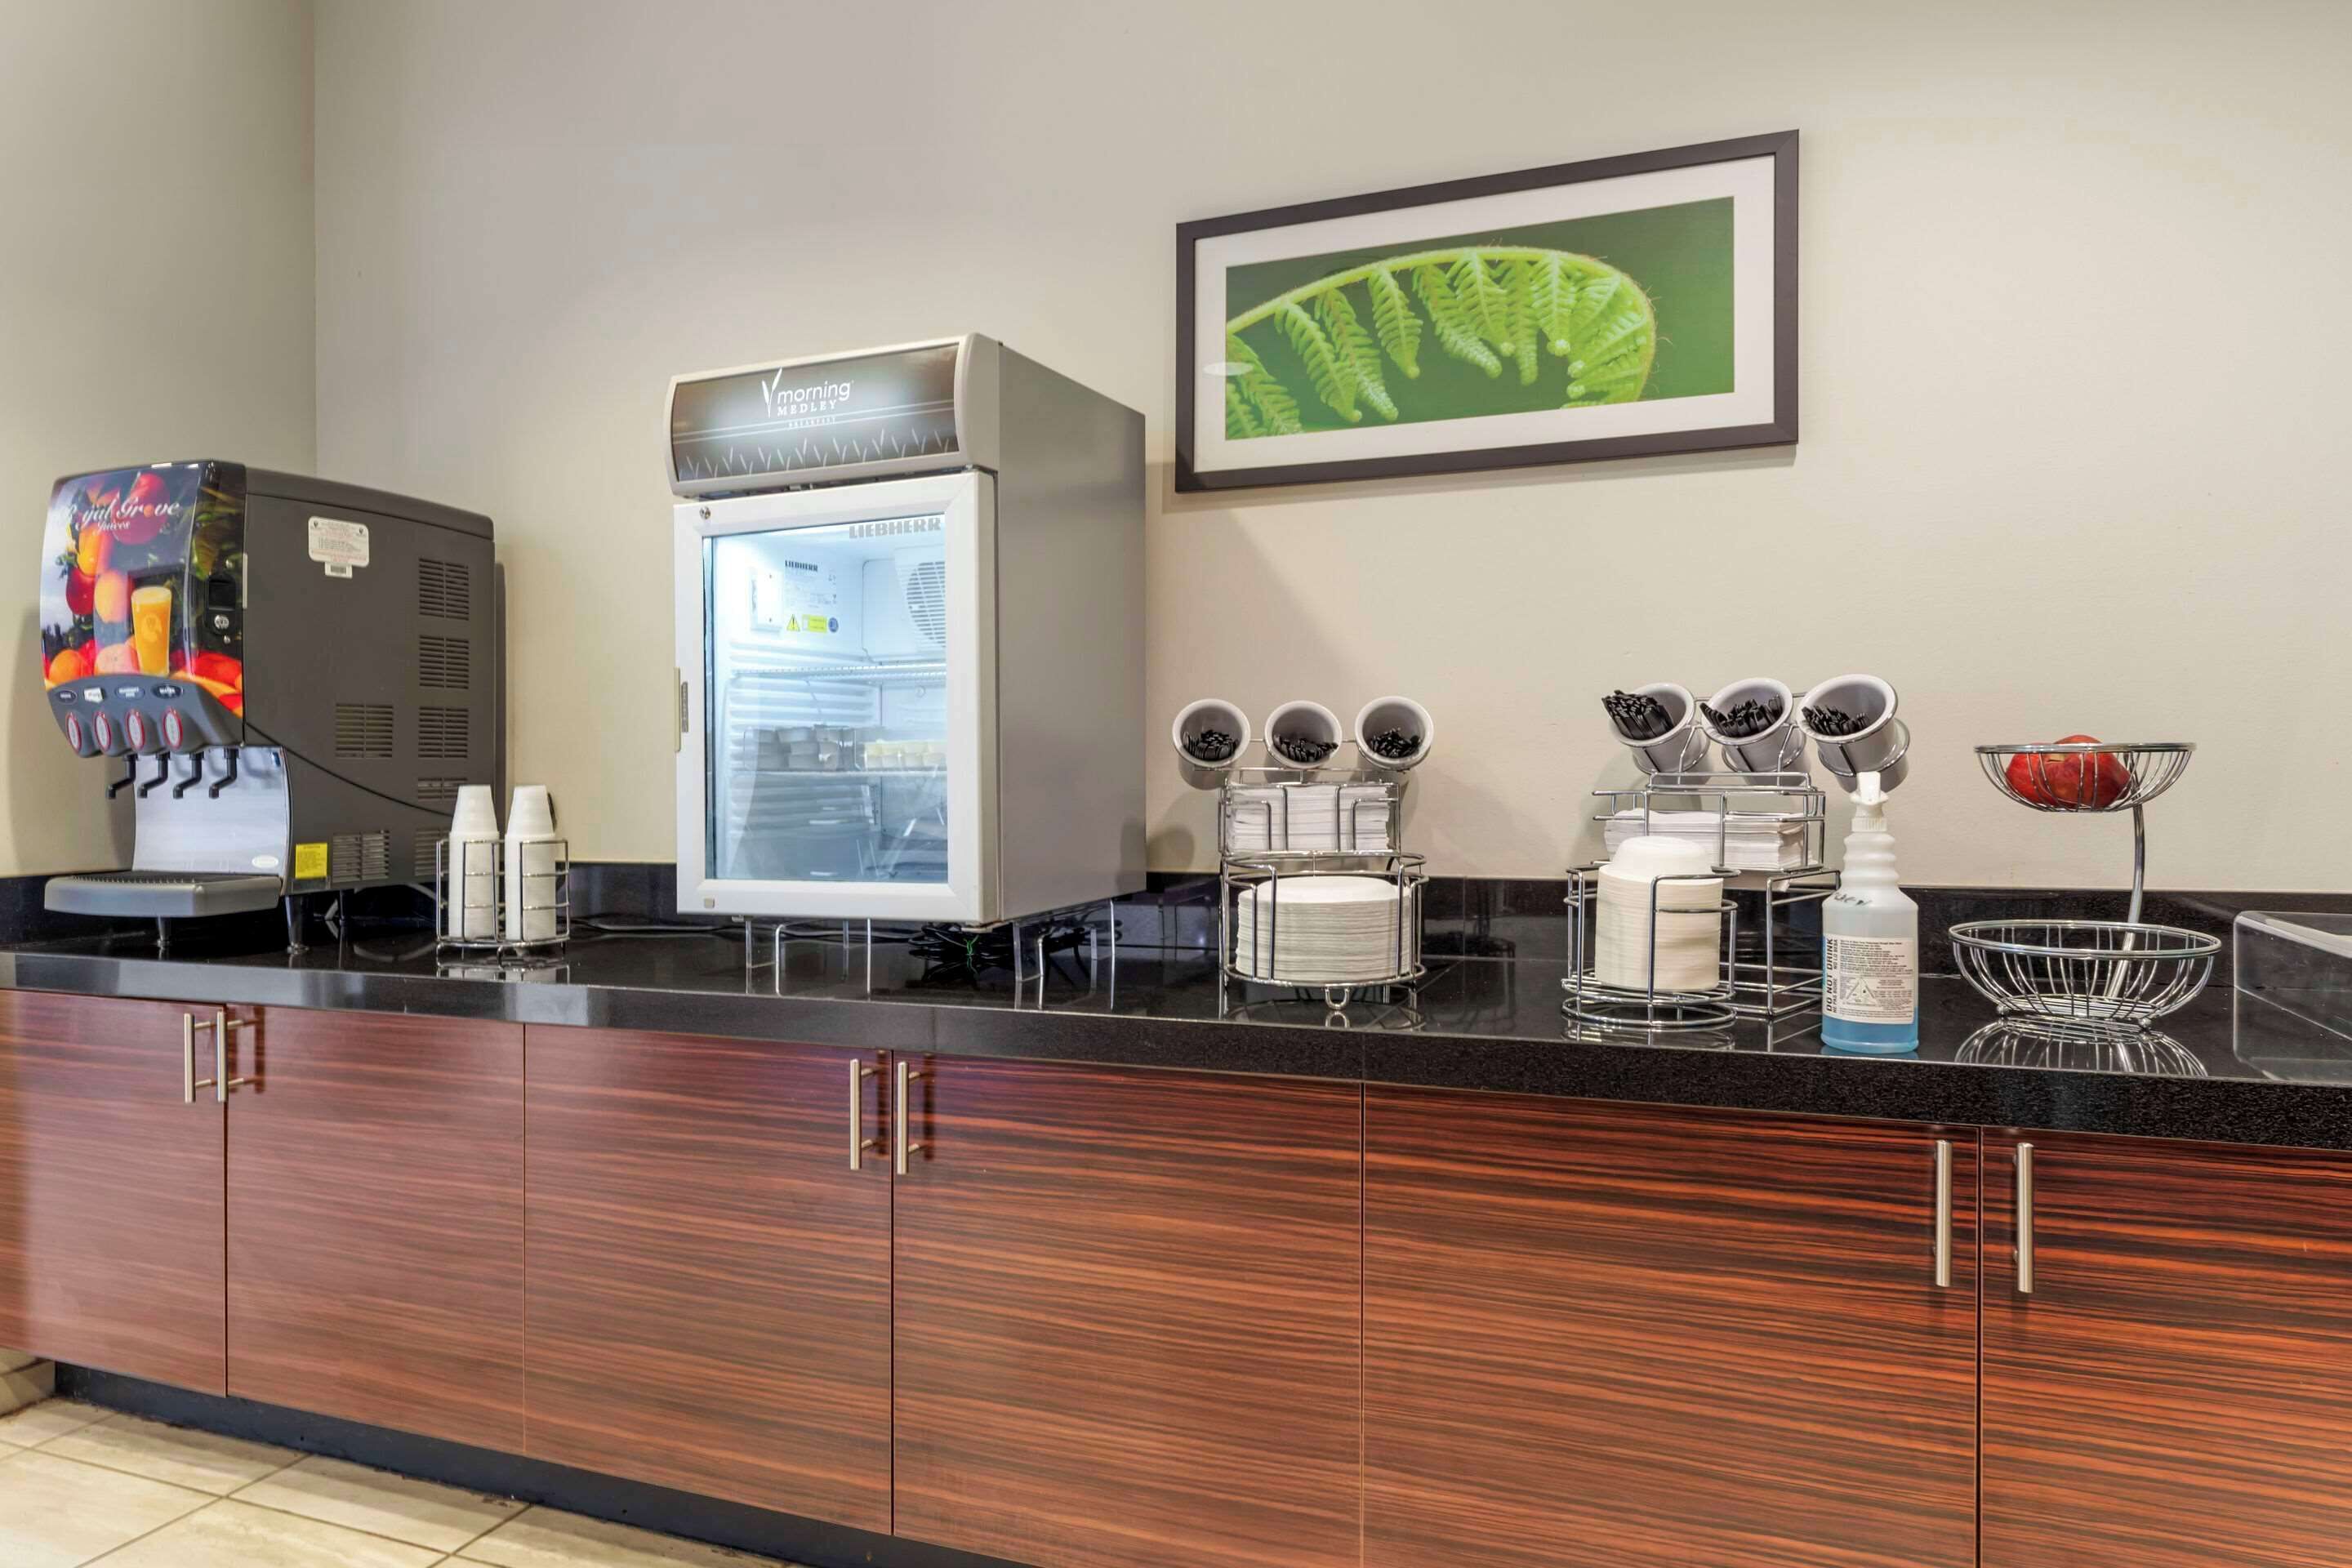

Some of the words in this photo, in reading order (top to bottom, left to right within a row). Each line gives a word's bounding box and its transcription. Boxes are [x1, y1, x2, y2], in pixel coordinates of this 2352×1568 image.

[777, 381, 851, 404] morning
[777, 399, 837, 416] MEDLEY
[849, 517, 942, 539] LIEBHERR
[1826, 998, 1833, 1012] DO
